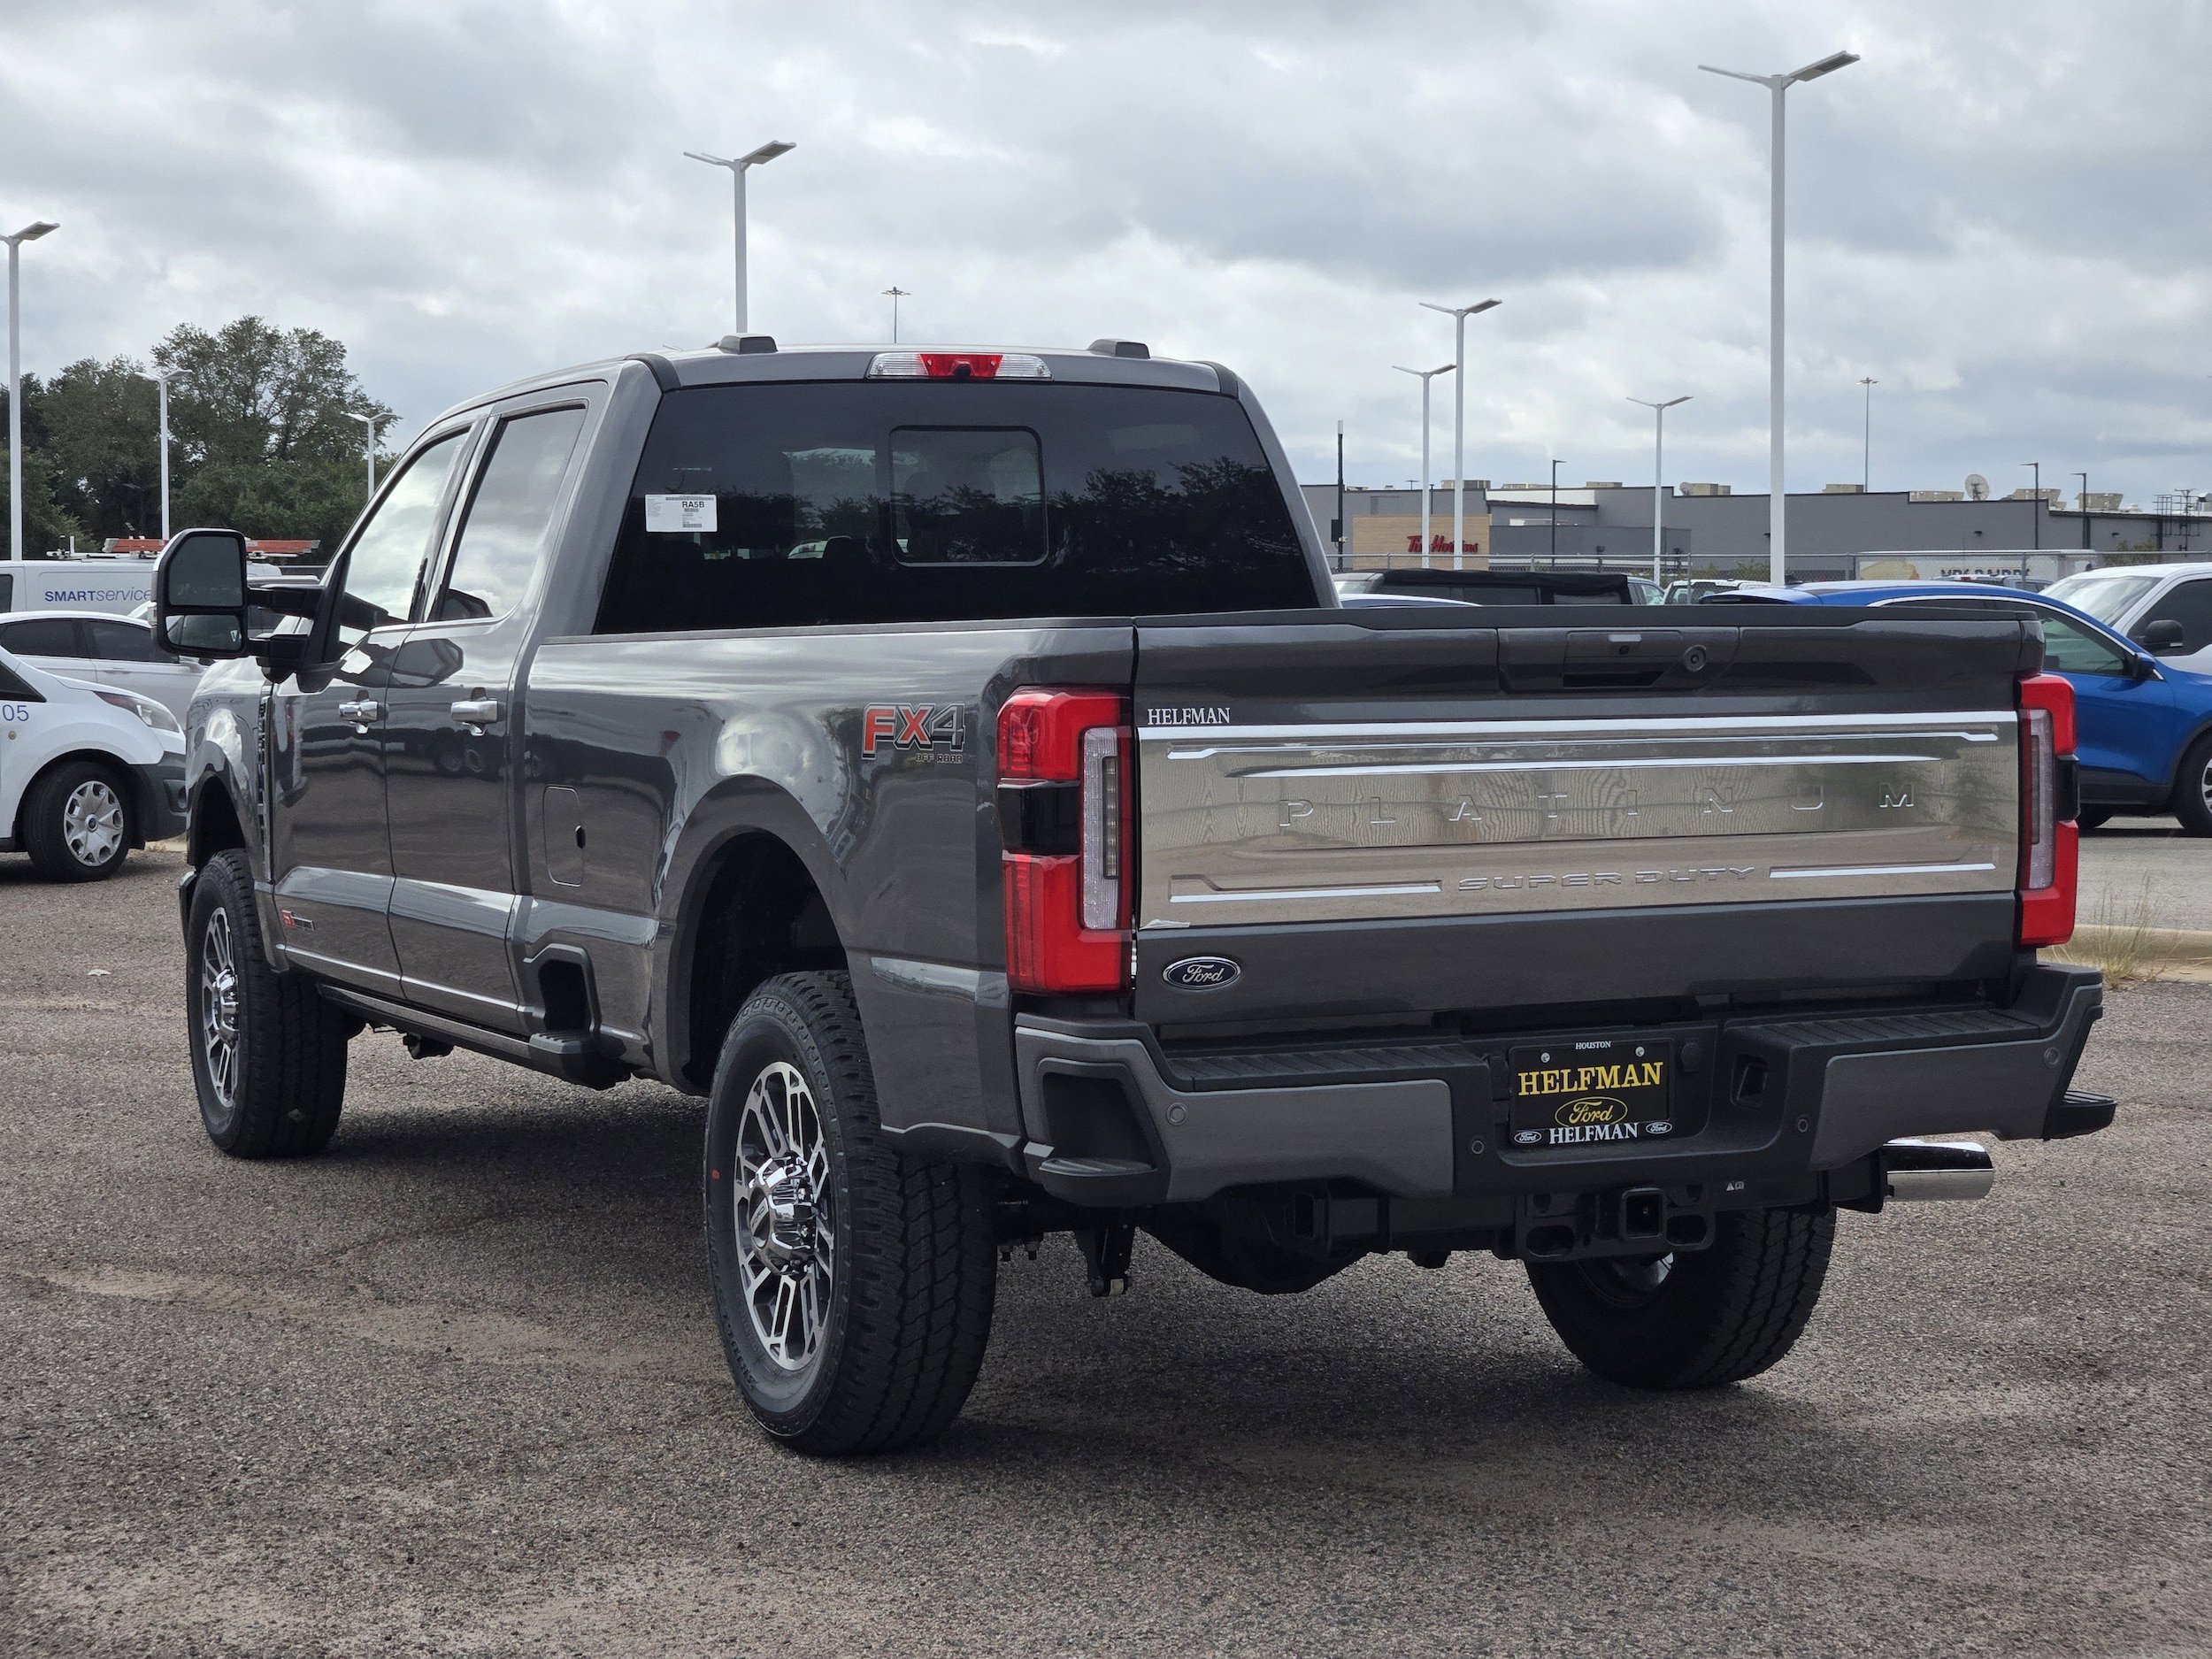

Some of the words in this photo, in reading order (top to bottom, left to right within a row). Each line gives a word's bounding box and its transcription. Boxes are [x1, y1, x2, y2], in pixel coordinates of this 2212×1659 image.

[2, 704, 29, 722] 05
[1147, 706, 1232, 726] HELFMAN
[861, 702, 966, 760] FX4
[915, 753, 935, 763] OFF
[936, 754, 964, 764] ROAD
[1279, 781, 1915, 828] PLATINUM
[1458, 871, 1623, 892] SUPER
[1635, 866, 1755, 885] DUTY
[1182, 964, 1225, 983] Ford
[1575, 1041, 1612, 1050] HOUSTON
[1517, 1061, 1664, 1096] HELFMAN
[1568, 1101, 1614, 1125] Ford
[1548, 1122, 1640, 1145] HELFMAN
